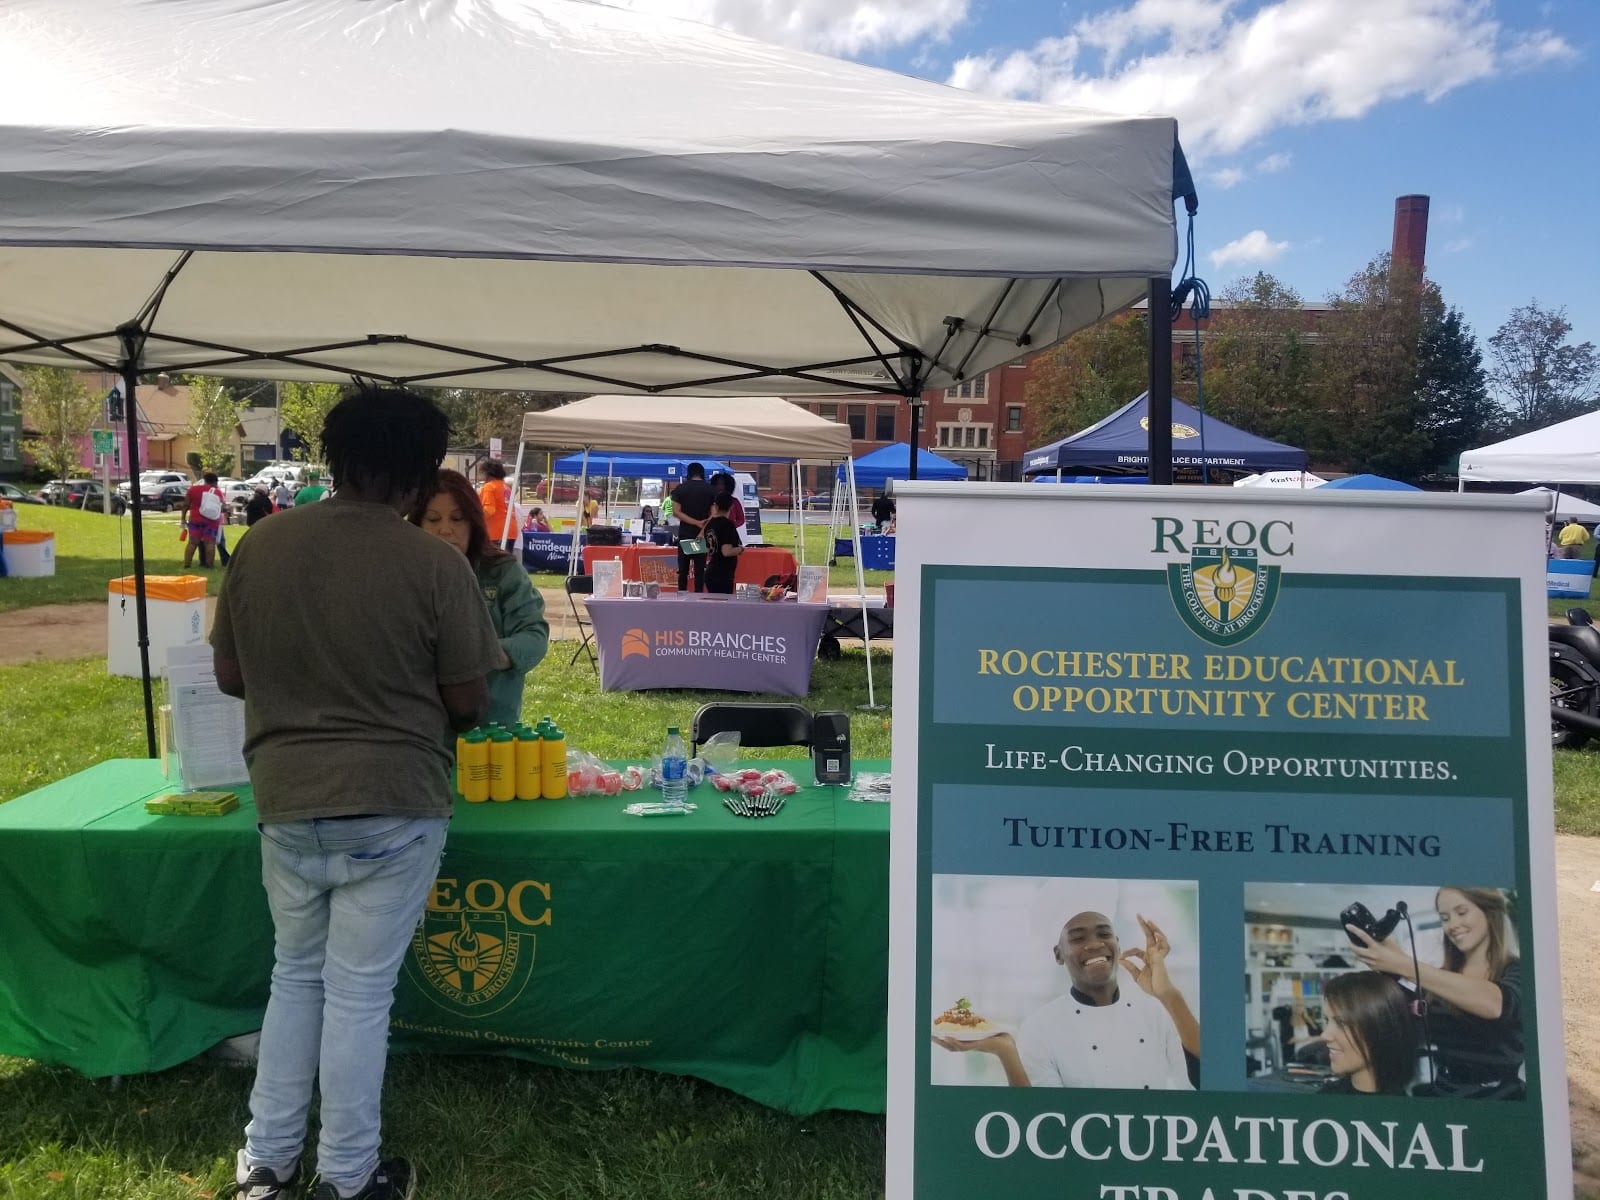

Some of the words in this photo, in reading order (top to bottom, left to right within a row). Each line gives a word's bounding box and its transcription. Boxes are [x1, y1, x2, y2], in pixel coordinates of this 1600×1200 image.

[1118, 456, 1149, 464] BRIGHT
[1192, 457, 1246, 465] DEPARTMENT
[1151, 517, 1294, 557] REOC
[1194, 548, 1255, 556] 1835
[1181, 566, 1192, 590] THE
[1186, 591, 1220, 632] COLLEGE
[1237, 568, 1268, 629] BROCKPORT
[655, 630, 685, 646] HIS
[688, 631, 787, 654] BRANCHES
[1223, 623, 1236, 635] AT
[655, 647, 712, 657] COMMUNITY
[714, 650, 749, 660] HEALTH
[751, 652, 787, 664] CENTER
[977, 649, 1192, 680] ROCHESTER
[1203, 654, 1465, 686] EDUCATIONAL
[1012, 685, 1273, 718] OPPORTUNITY
[1287, 692, 1431, 721] CENTER
[1265, 823, 1442, 858] TRAINING
[427, 878, 552, 926] EOC
[420, 956, 463, 1001] COLLEGE
[466, 994, 480, 1004] AT
[481, 933, 519, 999] BROCKPORT
[390, 1018, 479, 1040] ducational
[595, 1039, 653, 1049] Center
[974, 1110, 1484, 1173] OCCUPATIONAL
